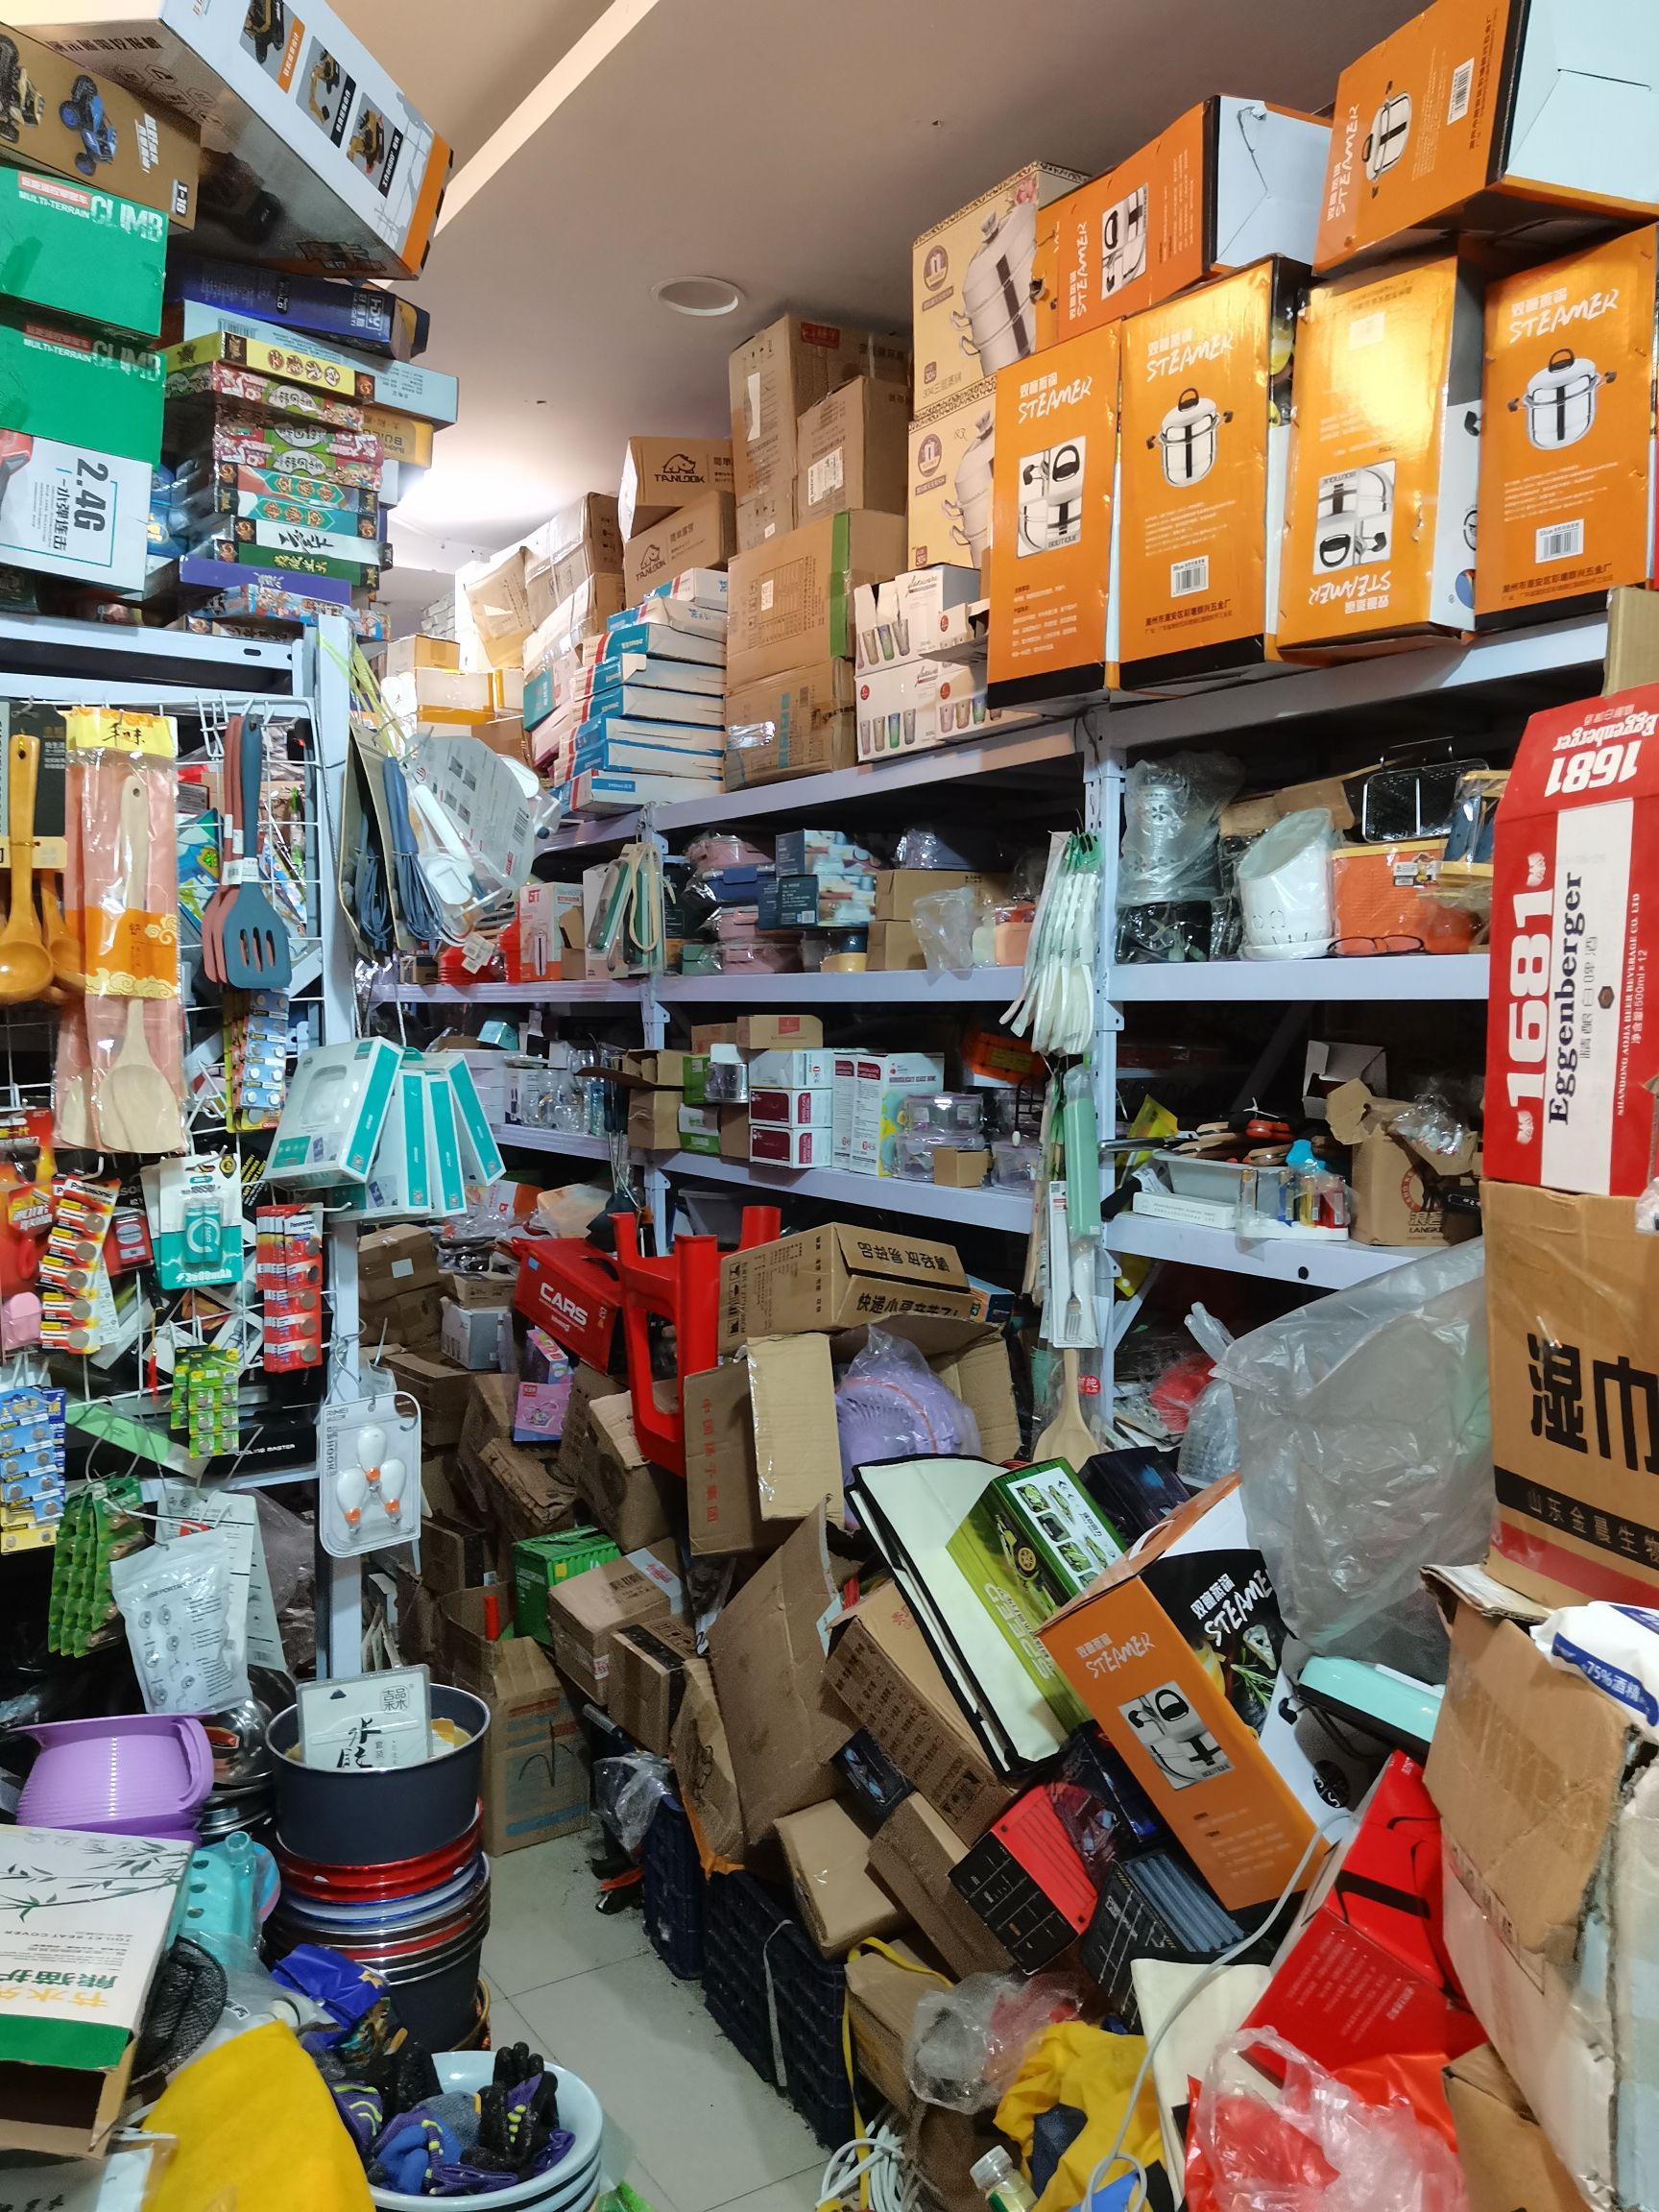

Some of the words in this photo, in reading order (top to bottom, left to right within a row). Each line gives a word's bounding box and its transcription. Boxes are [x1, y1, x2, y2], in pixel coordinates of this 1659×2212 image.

[1335, 105, 1358, 219] STEAMER
[18, 190, 90, 219] MULTI-TERRAIN
[1077, 222, 1089, 318] STEAMER
[1509, 289, 1620, 344] STEAMER
[23, 338, 91, 363] MULTI-TERRAIN
[1146, 332, 1235, 382] STEAMER
[1018, 375, 1093, 423] STEAMER
[74, 458, 108, 532] 2.4G
[1309, 570, 1392, 607] STEAMER
[1552, 710, 1659, 751] Eggenberger
[1544, 740, 1642, 798] 1681
[1631, 893, 1640, 914] LTD
[1626, 937, 1637, 990] BEVERAGE
[1637, 950, 1647, 961] 12
[1506, 888, 1554, 1107] 1681
[1549, 872, 1585, 1125] Eggenberger
[1624, 993, 1633, 1022] BEER
[1622, 1025, 1631, 1055] AOJIA
[1618, 1057, 1628, 1116] SHANDONG
[70, 1181, 113, 1200] Panasonic
[540, 1282, 589, 1327] CARS
[1527, 1333, 1659, 1475] 湿巾
[984, 1582, 1055, 1679] SPEED
[1204, 1569, 1273, 1647] STEAME
[1085, 1632, 1157, 1680] STEAMER
[1586, 1660, 1641, 1702] 75%酒精
